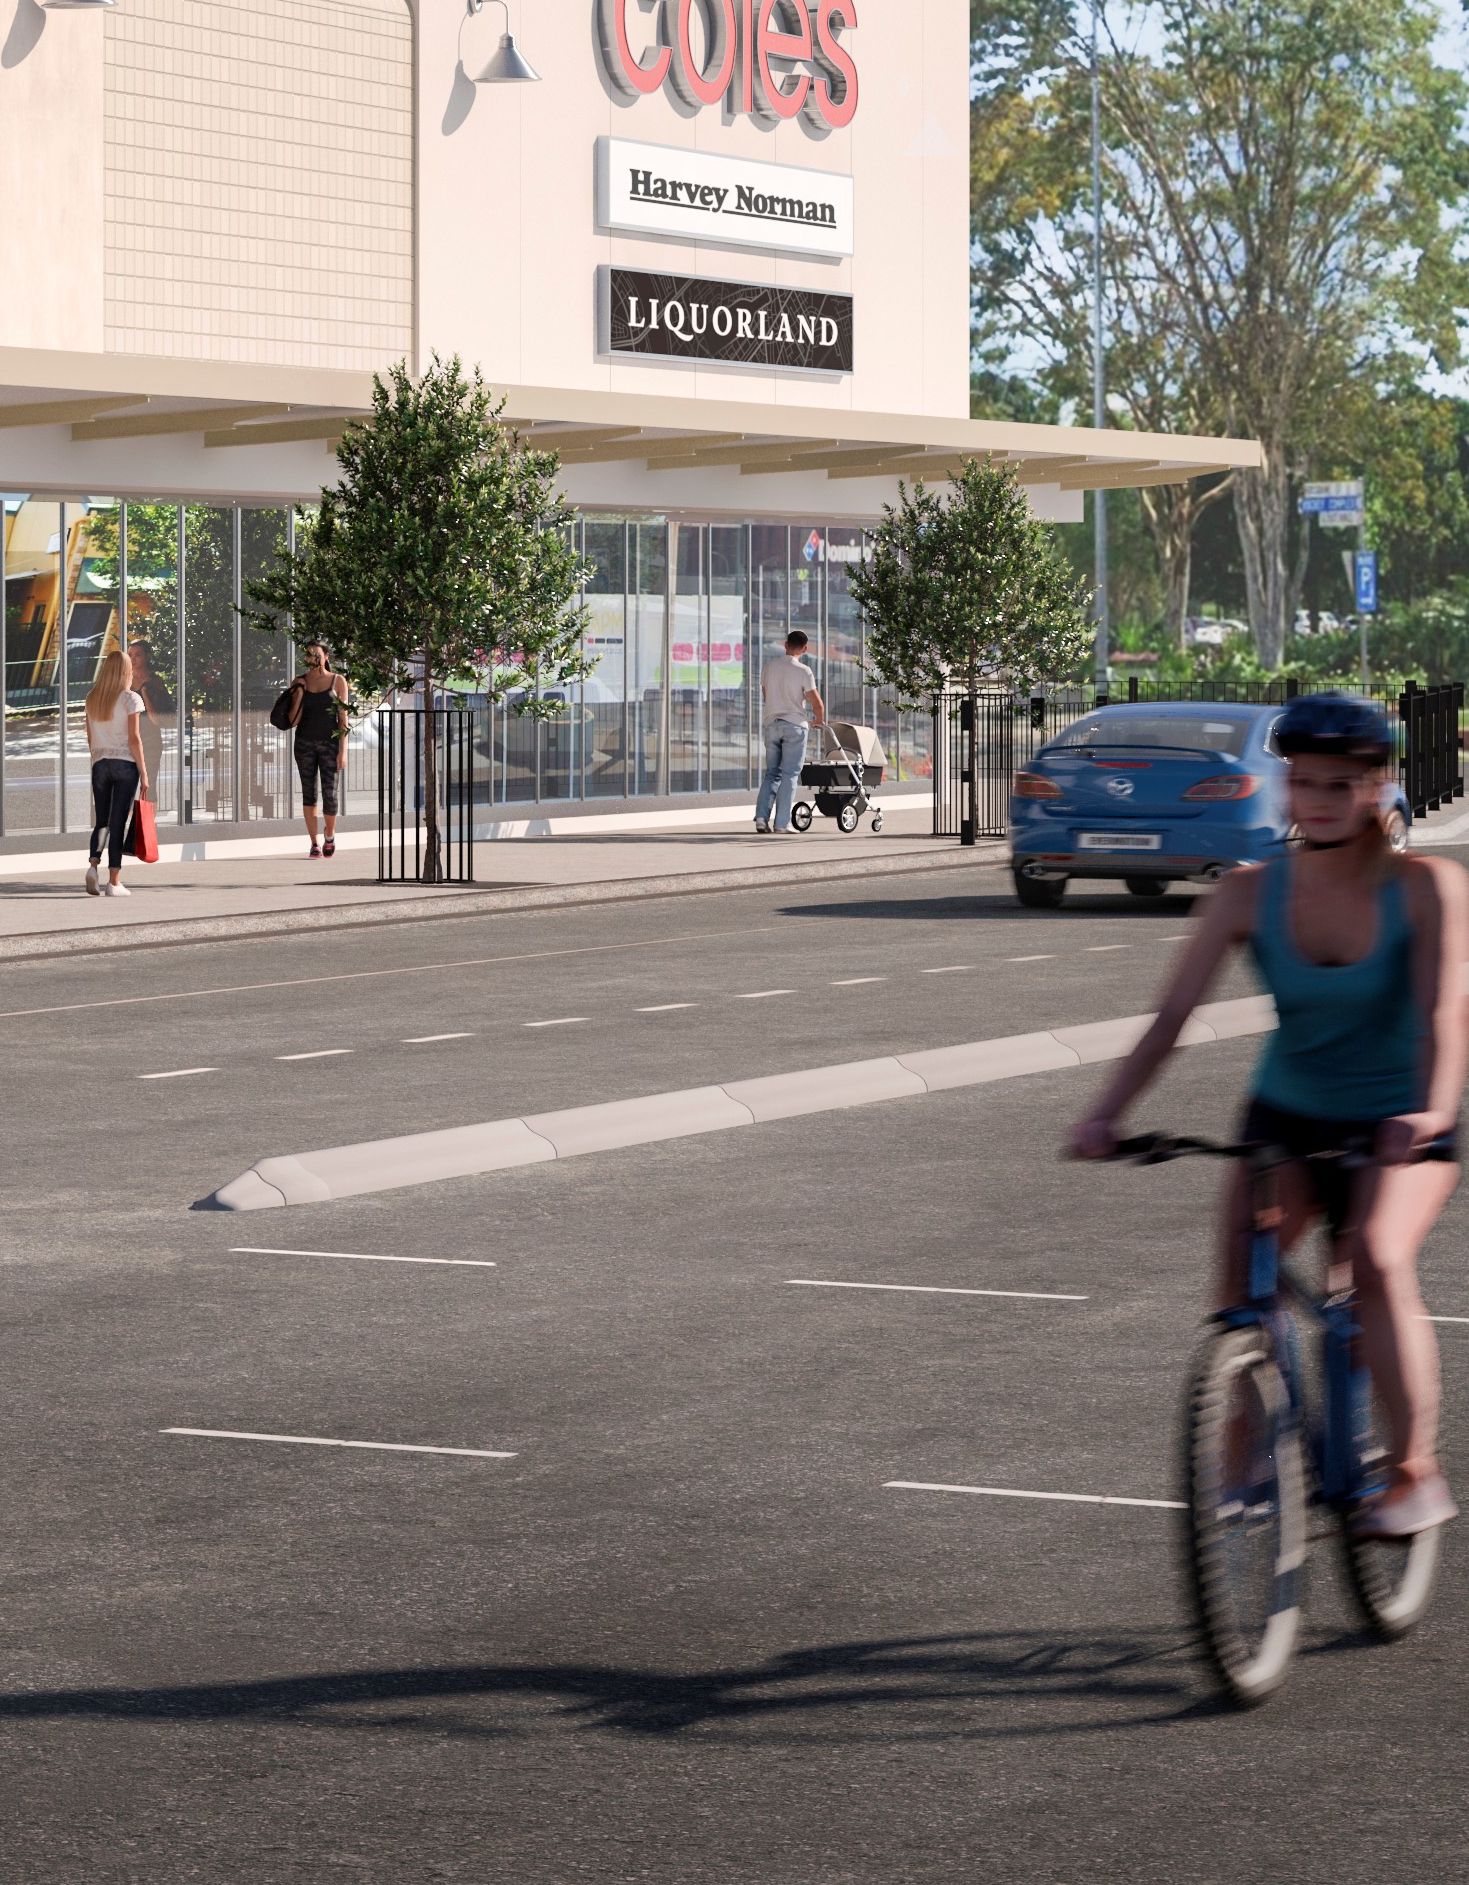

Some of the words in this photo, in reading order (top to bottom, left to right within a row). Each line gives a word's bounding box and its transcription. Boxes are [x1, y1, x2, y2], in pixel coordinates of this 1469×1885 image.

[629, 169, 729, 213] Harvey
[734, 184, 837, 224] Norman
[628, 296, 839, 347] LIQUORLAND
